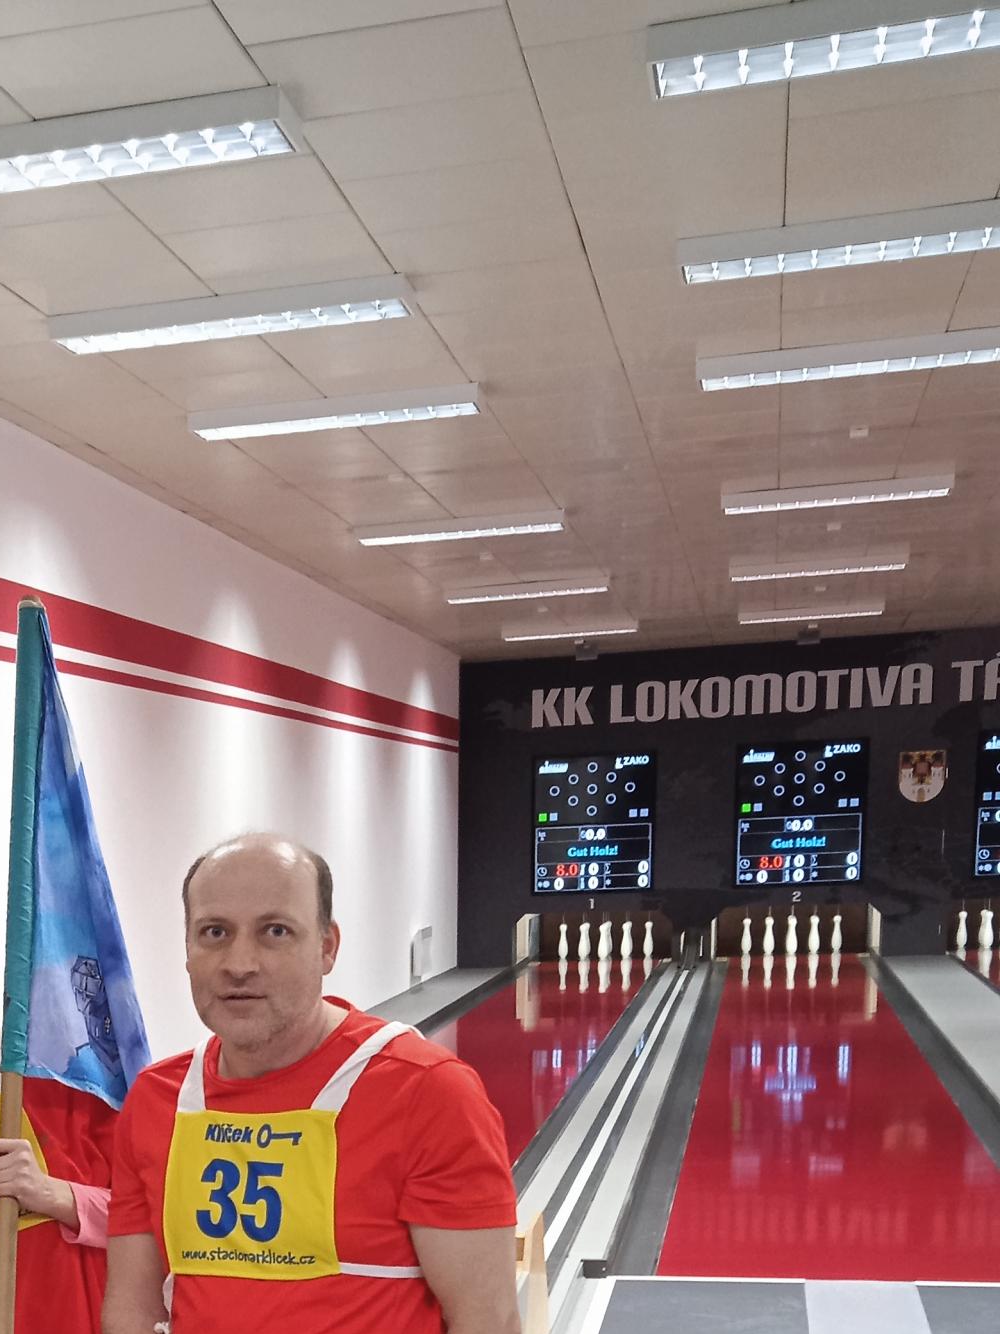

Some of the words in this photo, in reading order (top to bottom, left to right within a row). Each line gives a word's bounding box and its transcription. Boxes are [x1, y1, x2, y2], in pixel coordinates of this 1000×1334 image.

[531, 685, 595, 729] KK
[609, 662, 934, 724] LOKOMOTIVA
[770, 838, 794, 849] Gut
[795, 836, 826, 848] Holz!
[567, 846, 588, 857] Gut
[589, 845, 619, 857] Holz!
[760, 855, 783, 868] 8.0
[556, 863, 578, 876] 8.0
[792, 891, 802, 902] 2
[588, 898, 595, 910] 1
[204, 1122, 253, 1144] Klíček
[195, 1158, 284, 1243] 35
[181, 1246, 316, 1266] www.stacionarklicek.cz
